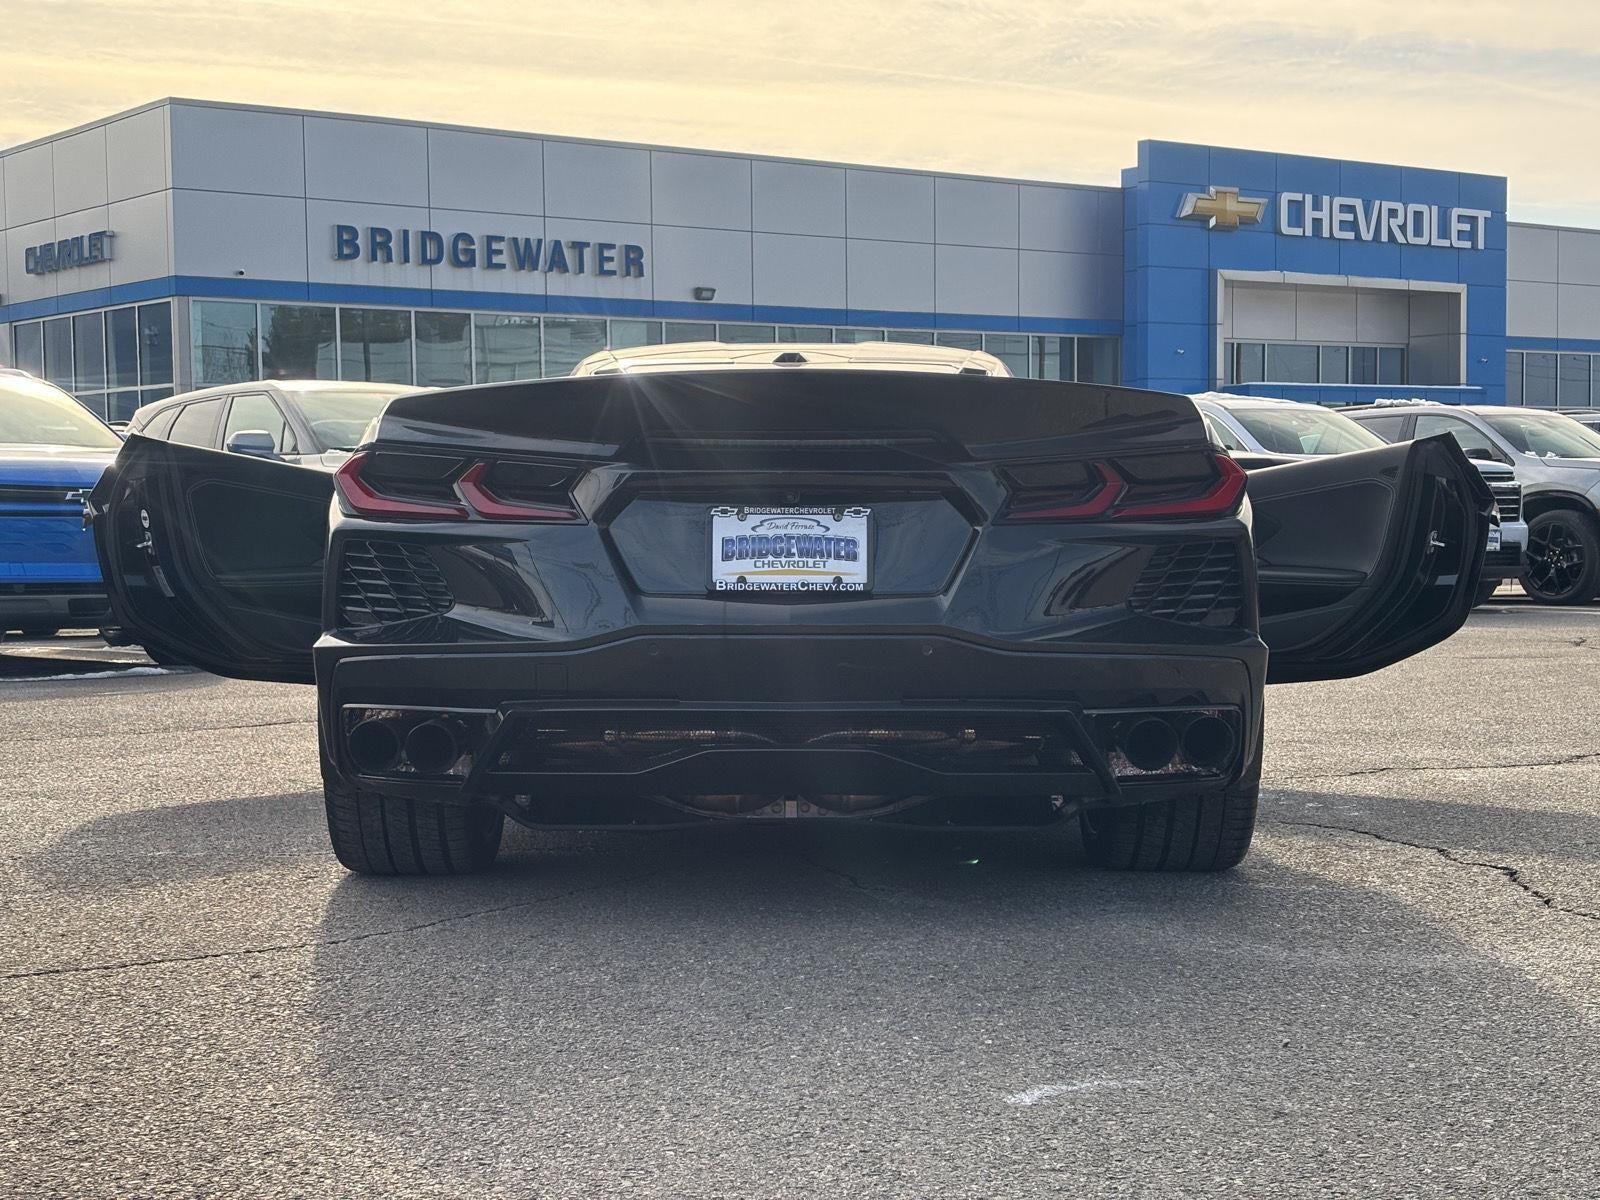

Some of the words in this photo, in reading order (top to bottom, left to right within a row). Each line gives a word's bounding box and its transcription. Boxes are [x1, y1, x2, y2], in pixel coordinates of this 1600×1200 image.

[1279, 191, 1492, 250] CHEVROLET
[25, 230, 115, 274] CHEVROLET
[334, 224, 645, 278] BRIDGEWATER
[721, 533, 860, 562] BRIDGEWATER
[753, 559, 829, 569] CHEVROLET
